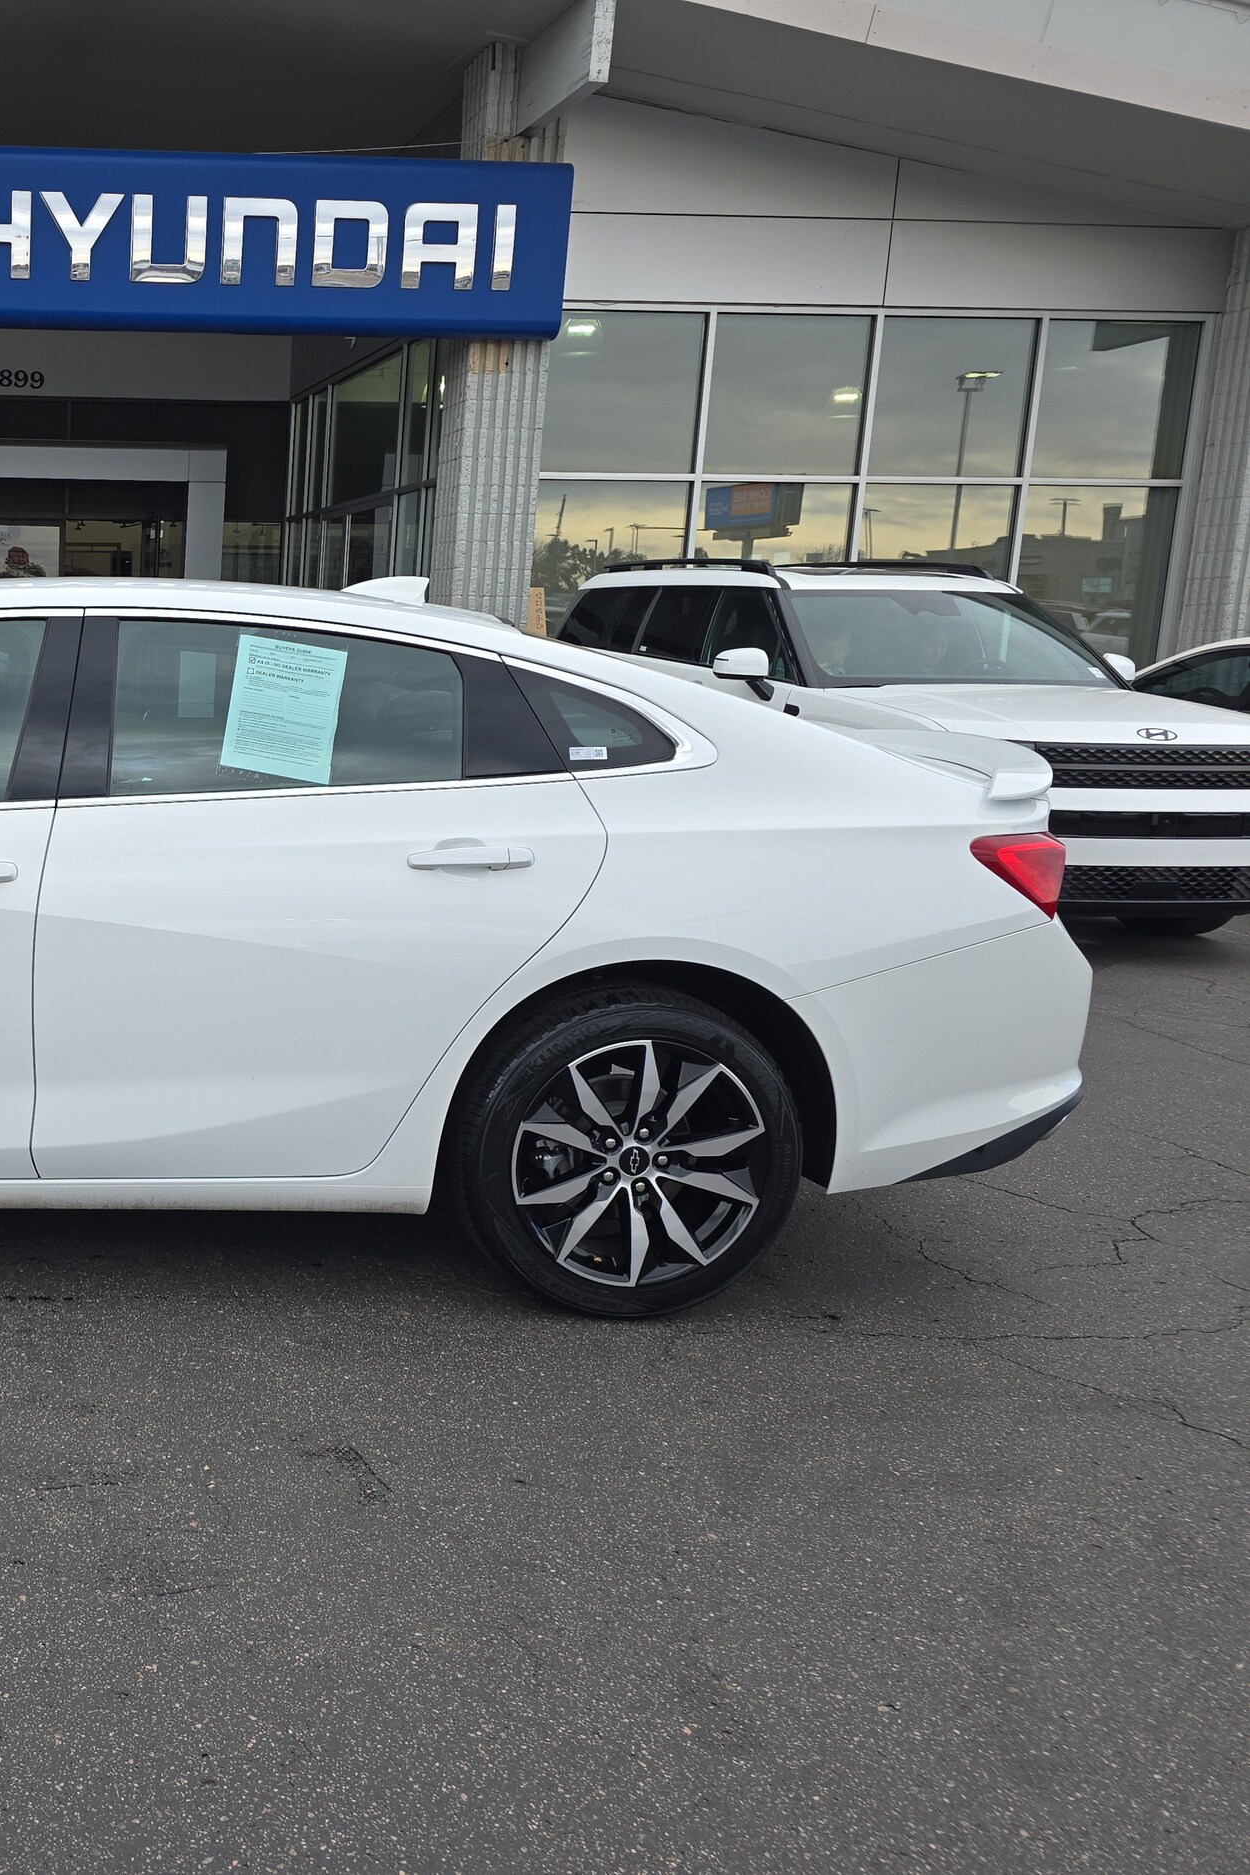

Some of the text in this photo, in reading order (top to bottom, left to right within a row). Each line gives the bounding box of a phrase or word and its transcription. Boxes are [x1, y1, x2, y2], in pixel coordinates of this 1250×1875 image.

[275, 644, 296, 652] BUYERS
[281, 664, 302, 672] DEALER
[302, 667, 331, 676] WARRANTY
[255, 670, 276, 678] DEALER
[276, 674, 305, 683] WARRANTY
[526, 1023, 601, 1074] KUMHO
